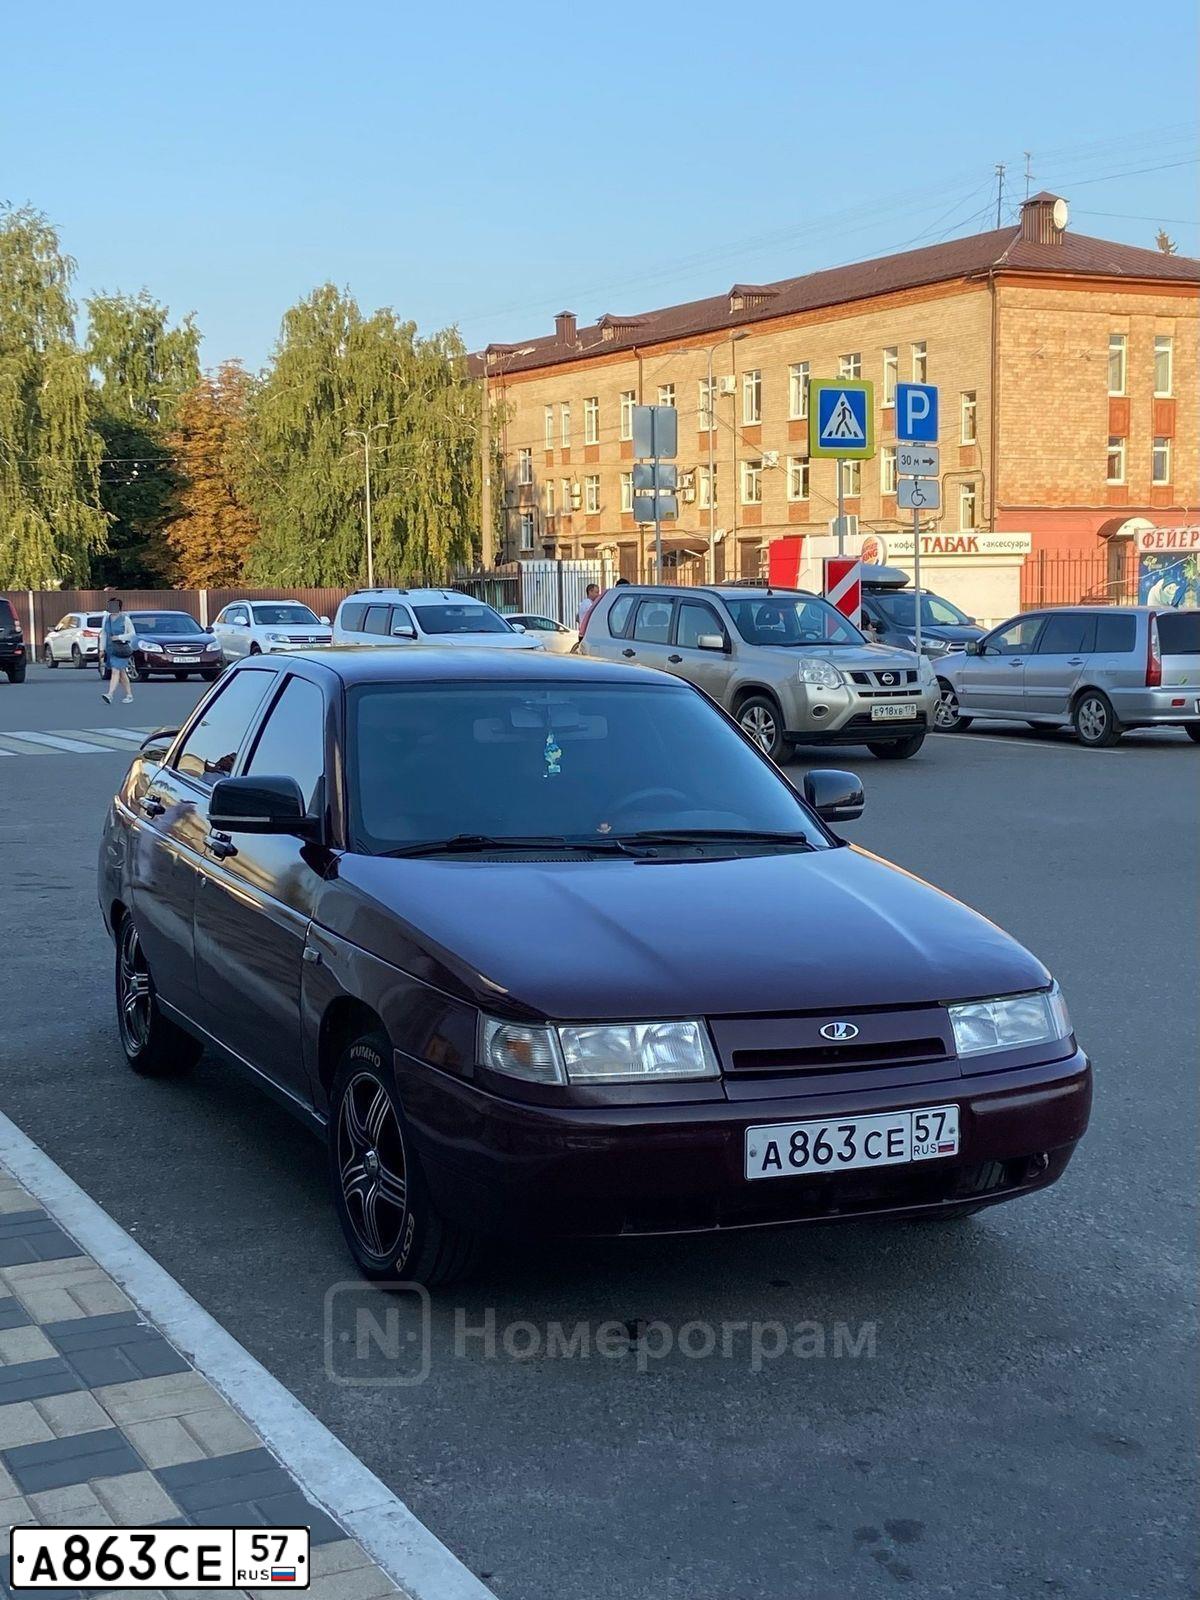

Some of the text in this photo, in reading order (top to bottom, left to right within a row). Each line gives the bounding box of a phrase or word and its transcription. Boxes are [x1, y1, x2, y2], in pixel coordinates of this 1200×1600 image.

[907, 390, 930, 434] P
[901, 454, 912, 466] 30
[894, 536, 1030, 553] кофе ТАБАК аксессуары
[1142, 530, 1199, 549] ФЕЙЕР
[914, 1112, 946, 1143] 57
[761, 1125, 904, 1171] А863СЕ
[913, 1144, 937, 1156] RUS
